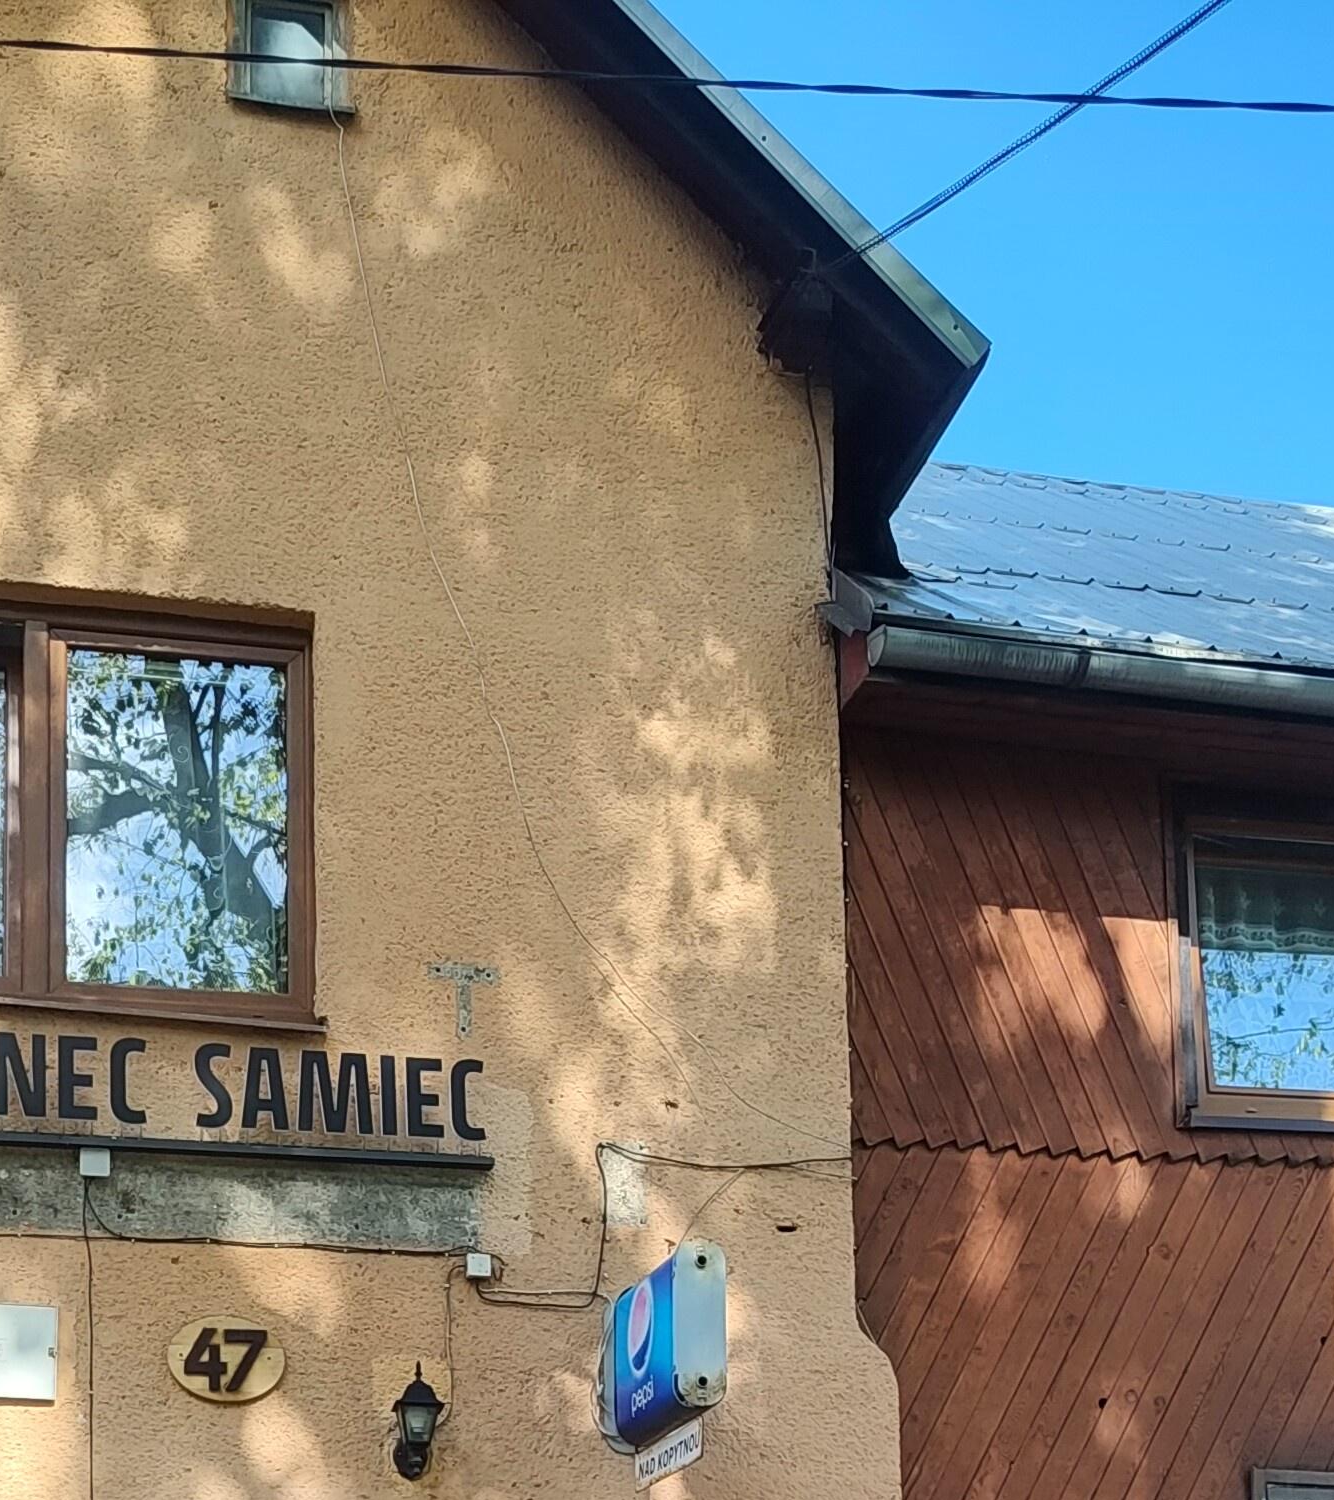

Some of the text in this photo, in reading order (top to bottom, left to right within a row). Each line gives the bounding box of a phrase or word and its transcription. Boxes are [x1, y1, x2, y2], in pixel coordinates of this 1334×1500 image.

[195, 1043, 486, 1141] SAMIEC
[183, 1327, 268, 1393] 47
[631, 1374, 654, 1418] pepsi
[638, 1430, 700, 1481] NAD KOPYTNOU
